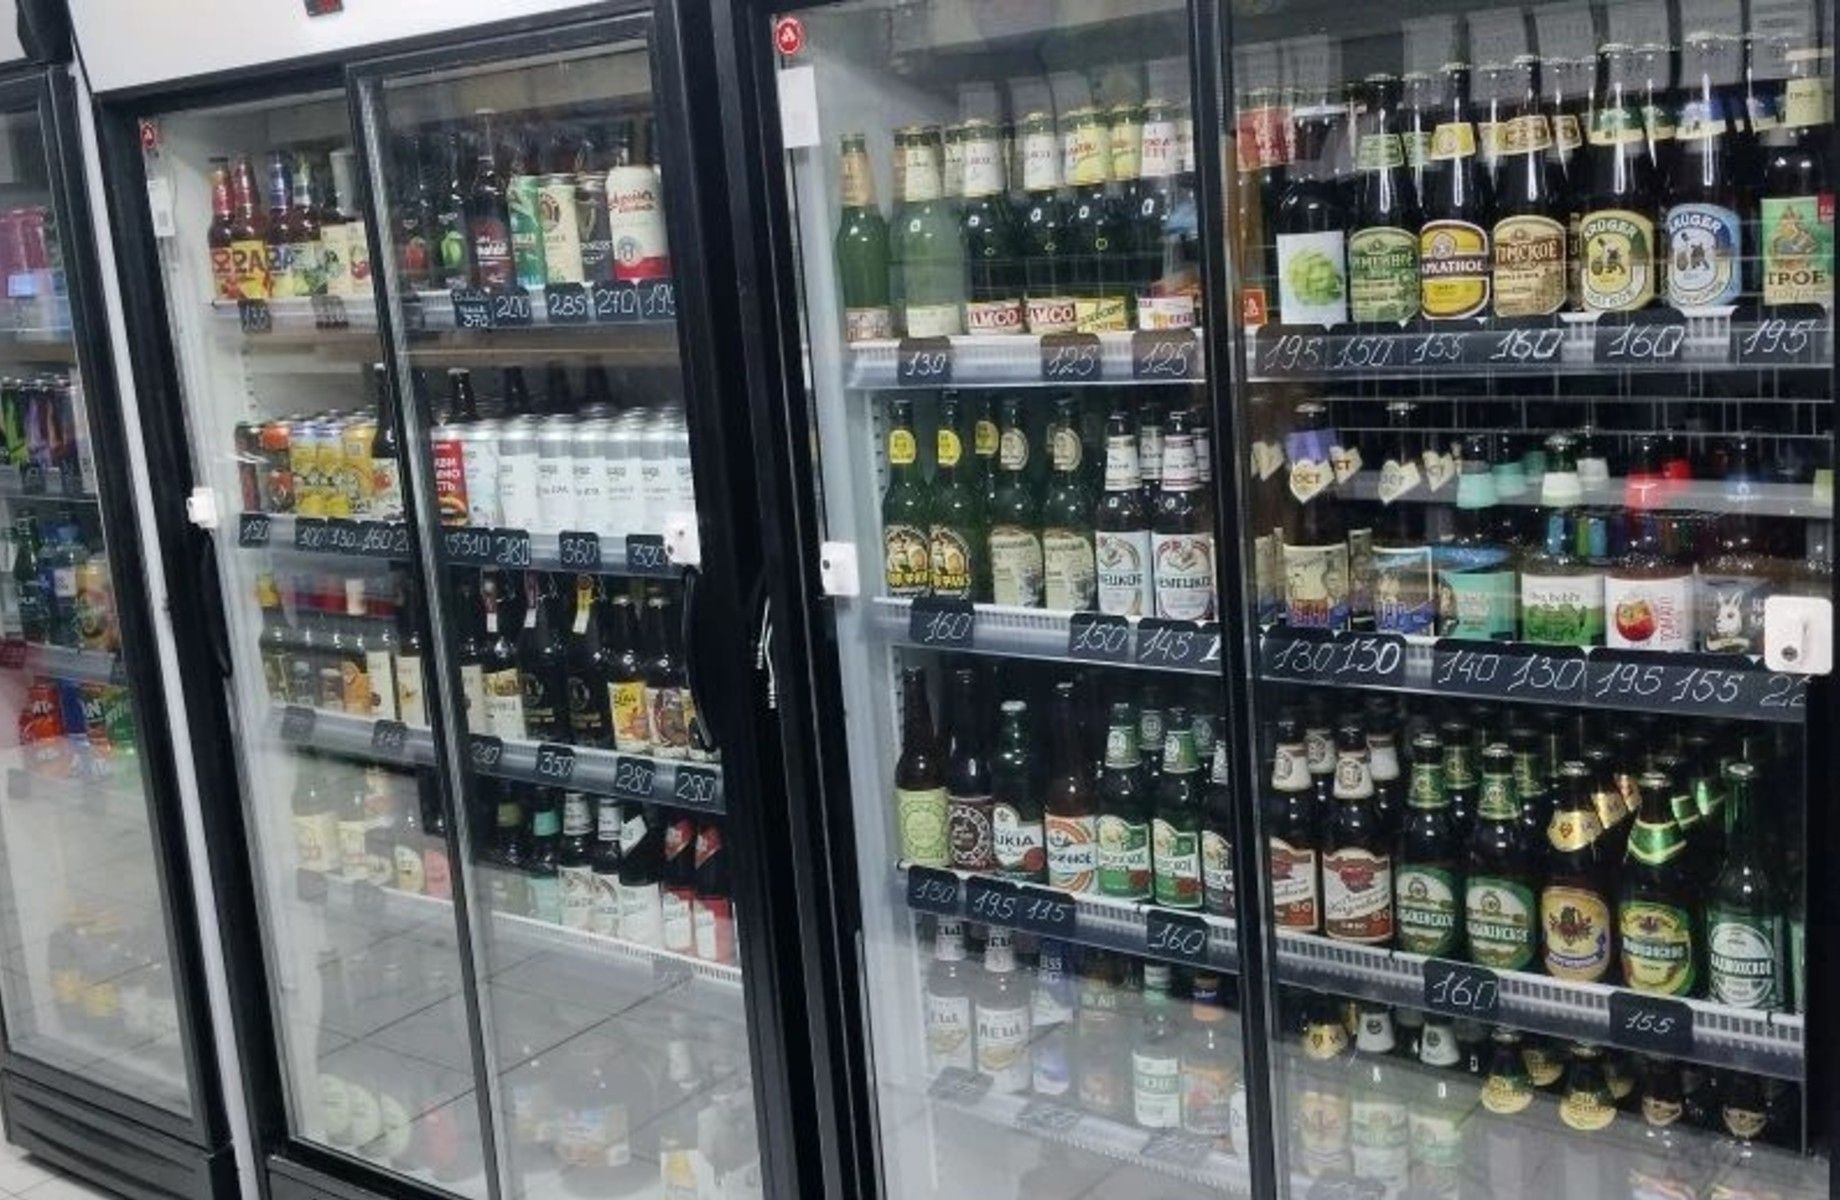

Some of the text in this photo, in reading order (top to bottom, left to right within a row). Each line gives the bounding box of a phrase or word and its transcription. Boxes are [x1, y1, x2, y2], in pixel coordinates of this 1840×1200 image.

[549, 293, 585, 316] 285
[596, 288, 637, 314] 270
[1263, 334, 1324, 371] 195
[1333, 335, 1395, 369] 150
[1489, 328, 1564, 359] 160
[1606, 323, 1685, 358] 160
[1743, 318, 1818, 355] 195
[905, 351, 947, 376] 130
[1048, 344, 1097, 376] 125
[1140, 342, 1196, 375] 125
[923, 610, 971, 642] 160
[1071, 619, 1128, 653] 150
[1139, 626, 1195, 661] 145
[1199, 631, 1222, 662] 1
[1274, 638, 1335, 673] 130
[1334, 637, 1400, 674] 130
[1437, 649, 1500, 684] 140
[1507, 653, 1585, 692] 130
[1595, 662, 1664, 698] 195
[1671, 667, 1744, 701] 155
[972, 889, 1017, 920] 195
[1147, 922, 1206, 954] 160
[1432, 970, 1498, 1011] 160
[1625, 1010, 1676, 1034] 155
